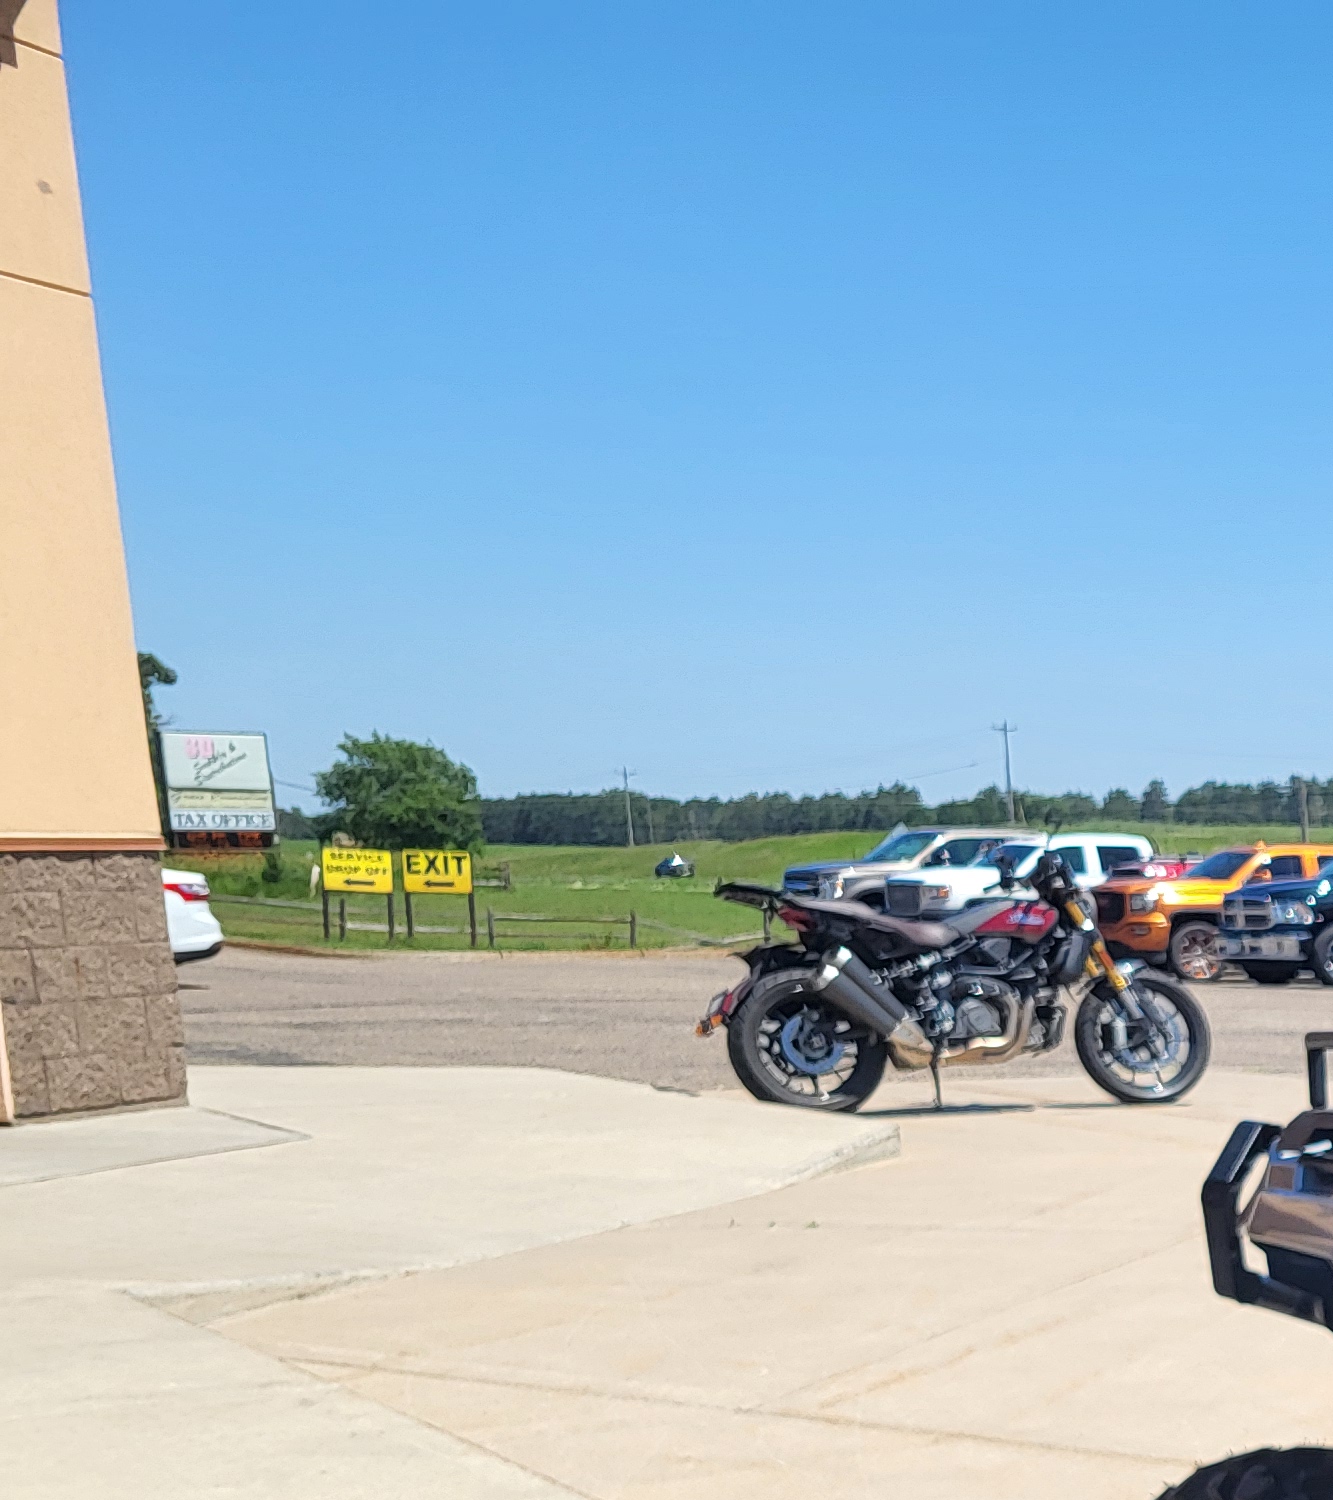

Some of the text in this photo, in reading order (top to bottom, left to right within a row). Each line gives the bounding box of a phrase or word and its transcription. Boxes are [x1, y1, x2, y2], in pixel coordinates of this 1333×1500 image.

[174, 813, 273, 828] TAX OFFICE
[406, 854, 467, 876] EXIT
